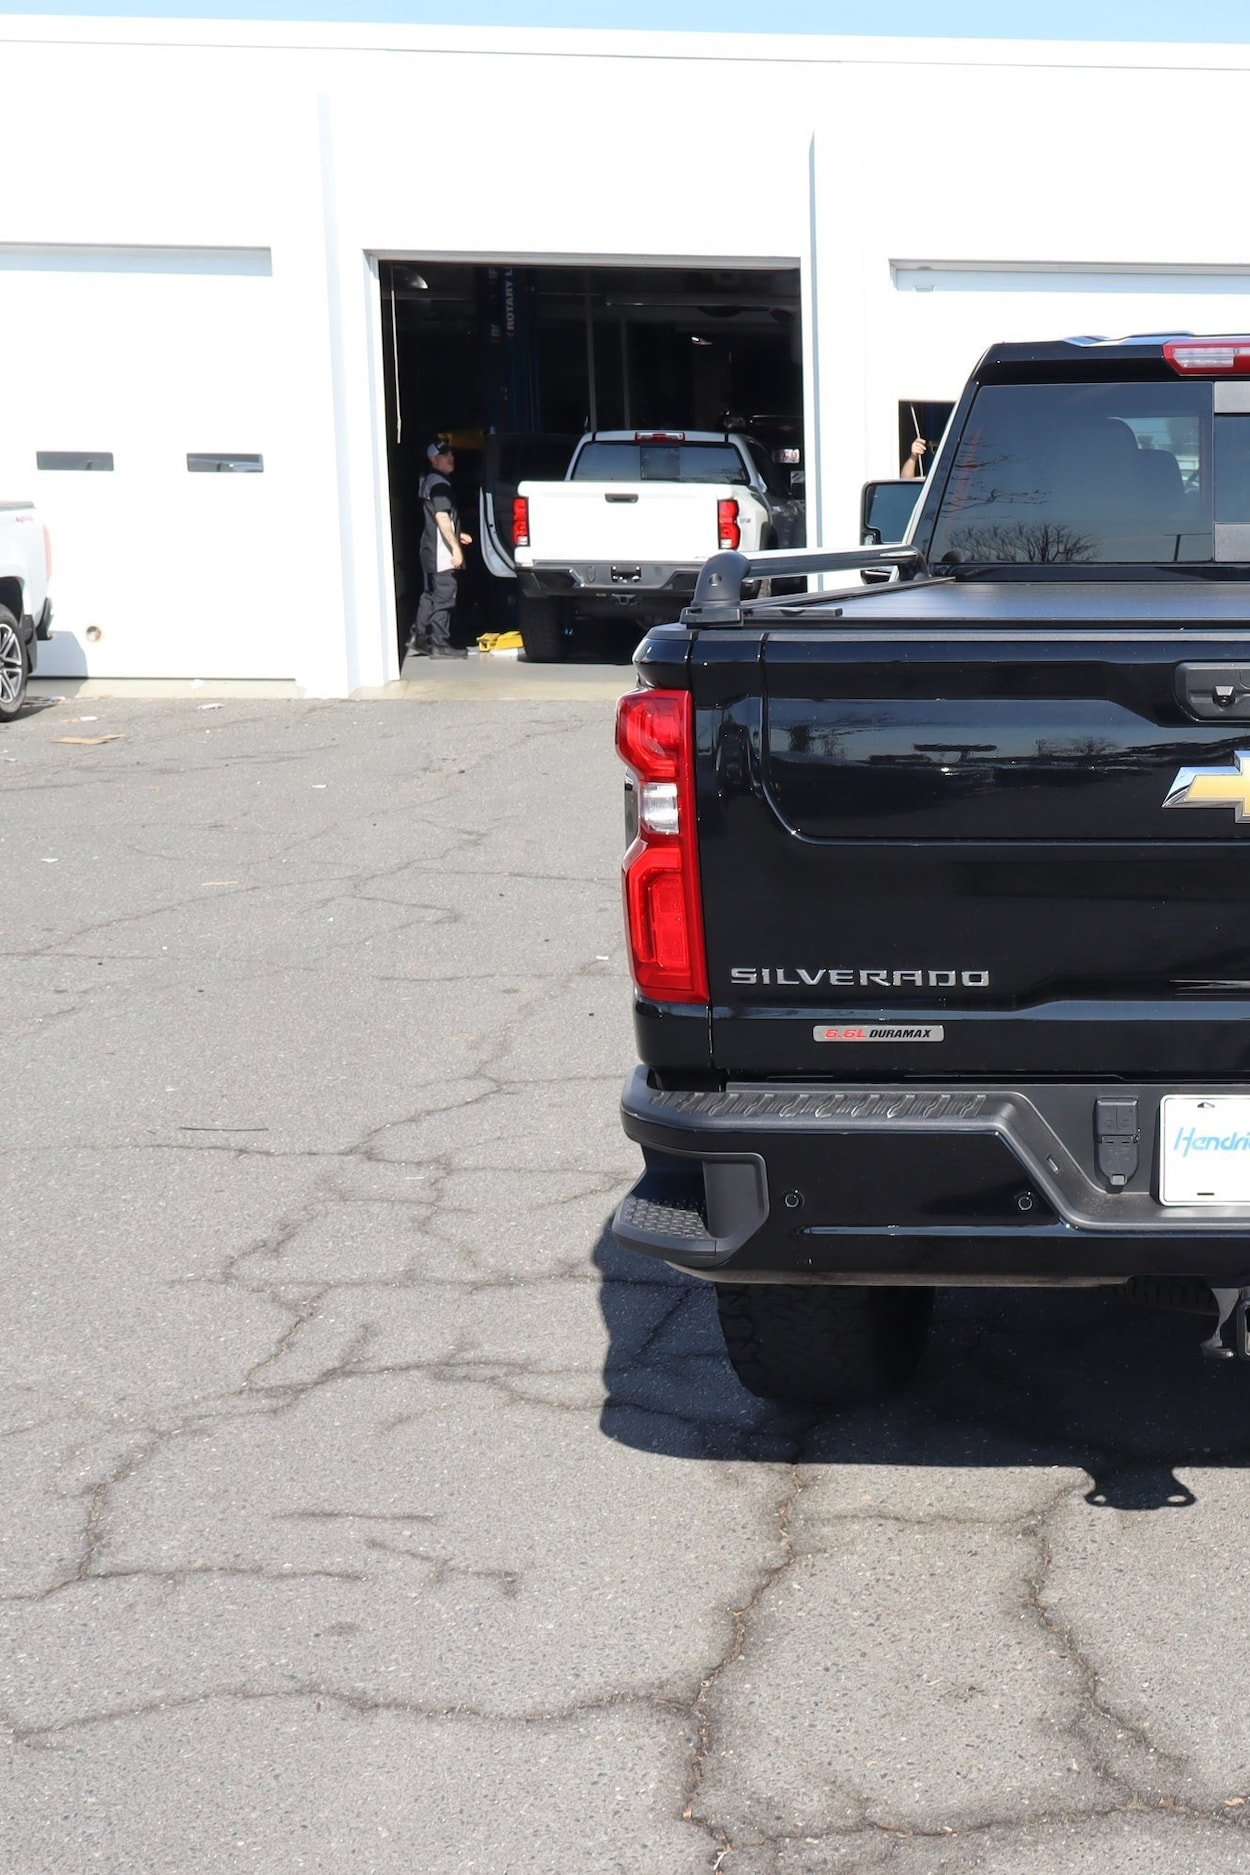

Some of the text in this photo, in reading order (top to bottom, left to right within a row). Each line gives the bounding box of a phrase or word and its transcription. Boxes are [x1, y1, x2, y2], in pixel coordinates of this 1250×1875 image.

[505, 280, 515, 330] ROTARY
[730, 967, 990, 987] SILVERADO
[869, 1028, 932, 1039] DURAMAX
